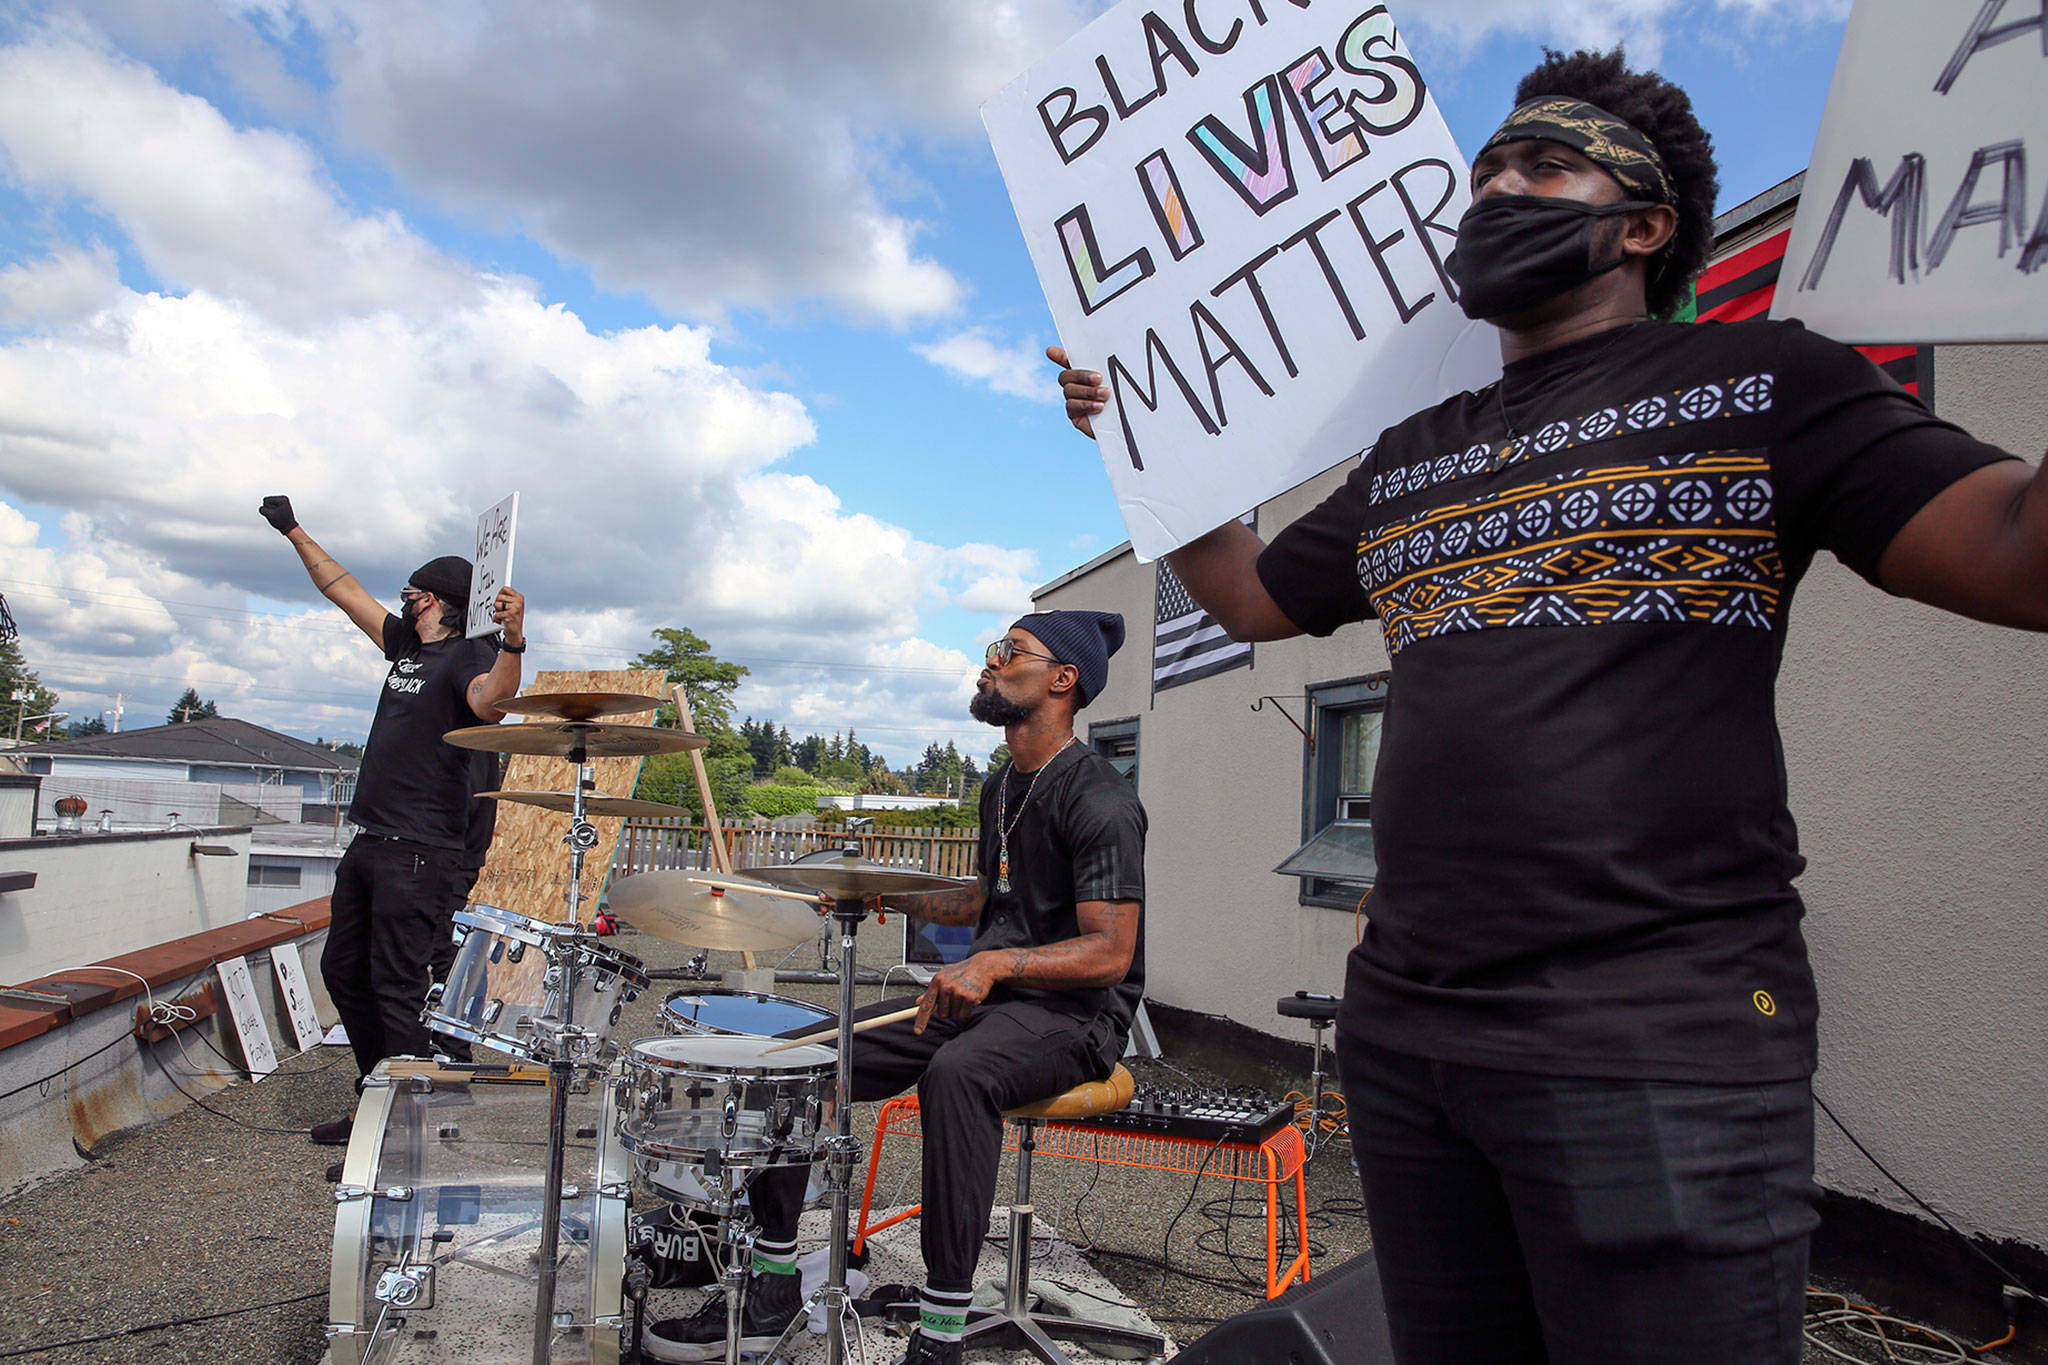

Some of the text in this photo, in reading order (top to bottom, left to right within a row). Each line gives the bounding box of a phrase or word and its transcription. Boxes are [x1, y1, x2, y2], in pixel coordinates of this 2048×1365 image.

[1036, 0, 1311, 165] BLAC
[1054, 4, 1427, 316] LIVES
[1107, 157, 1458, 471] MATTER
[1798, 137, 2048, 293] MA
